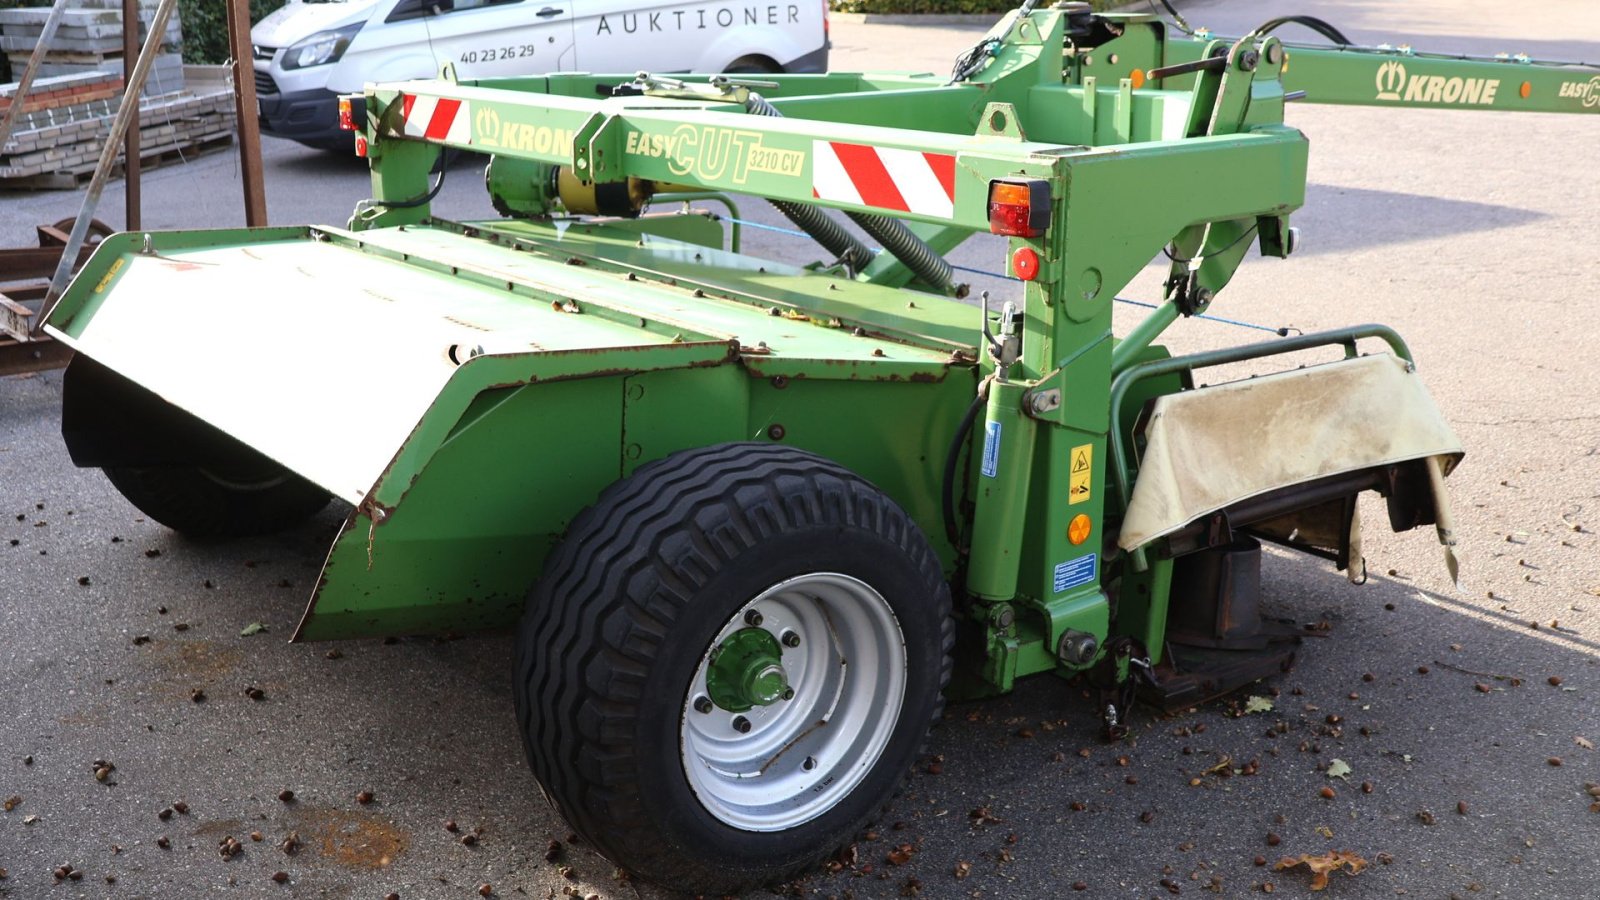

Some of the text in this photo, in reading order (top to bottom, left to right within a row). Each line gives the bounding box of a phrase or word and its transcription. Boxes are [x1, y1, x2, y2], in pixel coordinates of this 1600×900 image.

[596, 4, 799, 36] AUKTIONER
[460, 44, 535, 64] 40 23 26 29
[1403, 74, 1501, 105] KRONE
[501, 121, 573, 158] KRON
[749, 149, 779, 171] 3210
[781, 151, 801, 173] CV
